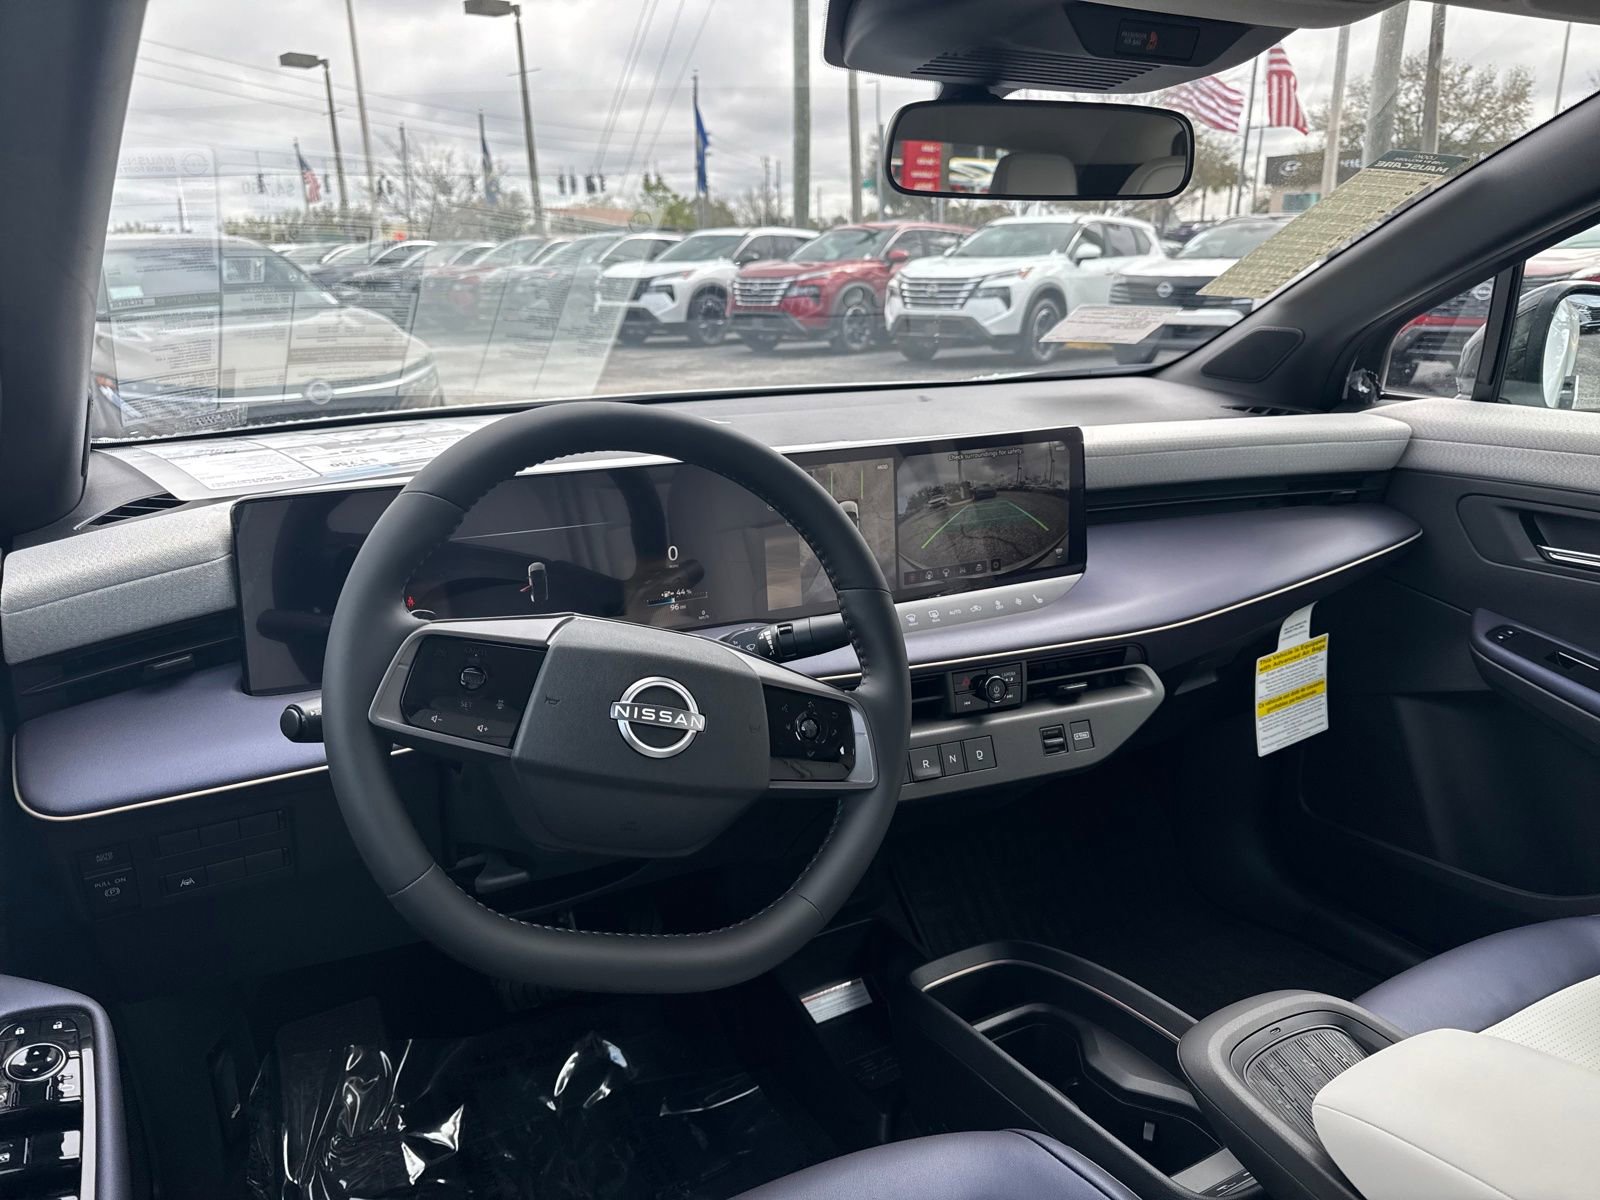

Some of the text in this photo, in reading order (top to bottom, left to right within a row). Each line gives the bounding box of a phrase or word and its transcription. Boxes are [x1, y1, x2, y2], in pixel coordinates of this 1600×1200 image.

[965, 451, 997, 459] surroundings
[667, 545, 679, 561] 0
[676, 588, 686, 596] 44
[1273, 654, 1300, 666] Advanced
[460, 700, 472, 708] SET
[613, 704, 704, 732] NISSAN
[922, 750, 984, 769] R N D
[94, 876, 127, 889] PULL ON
